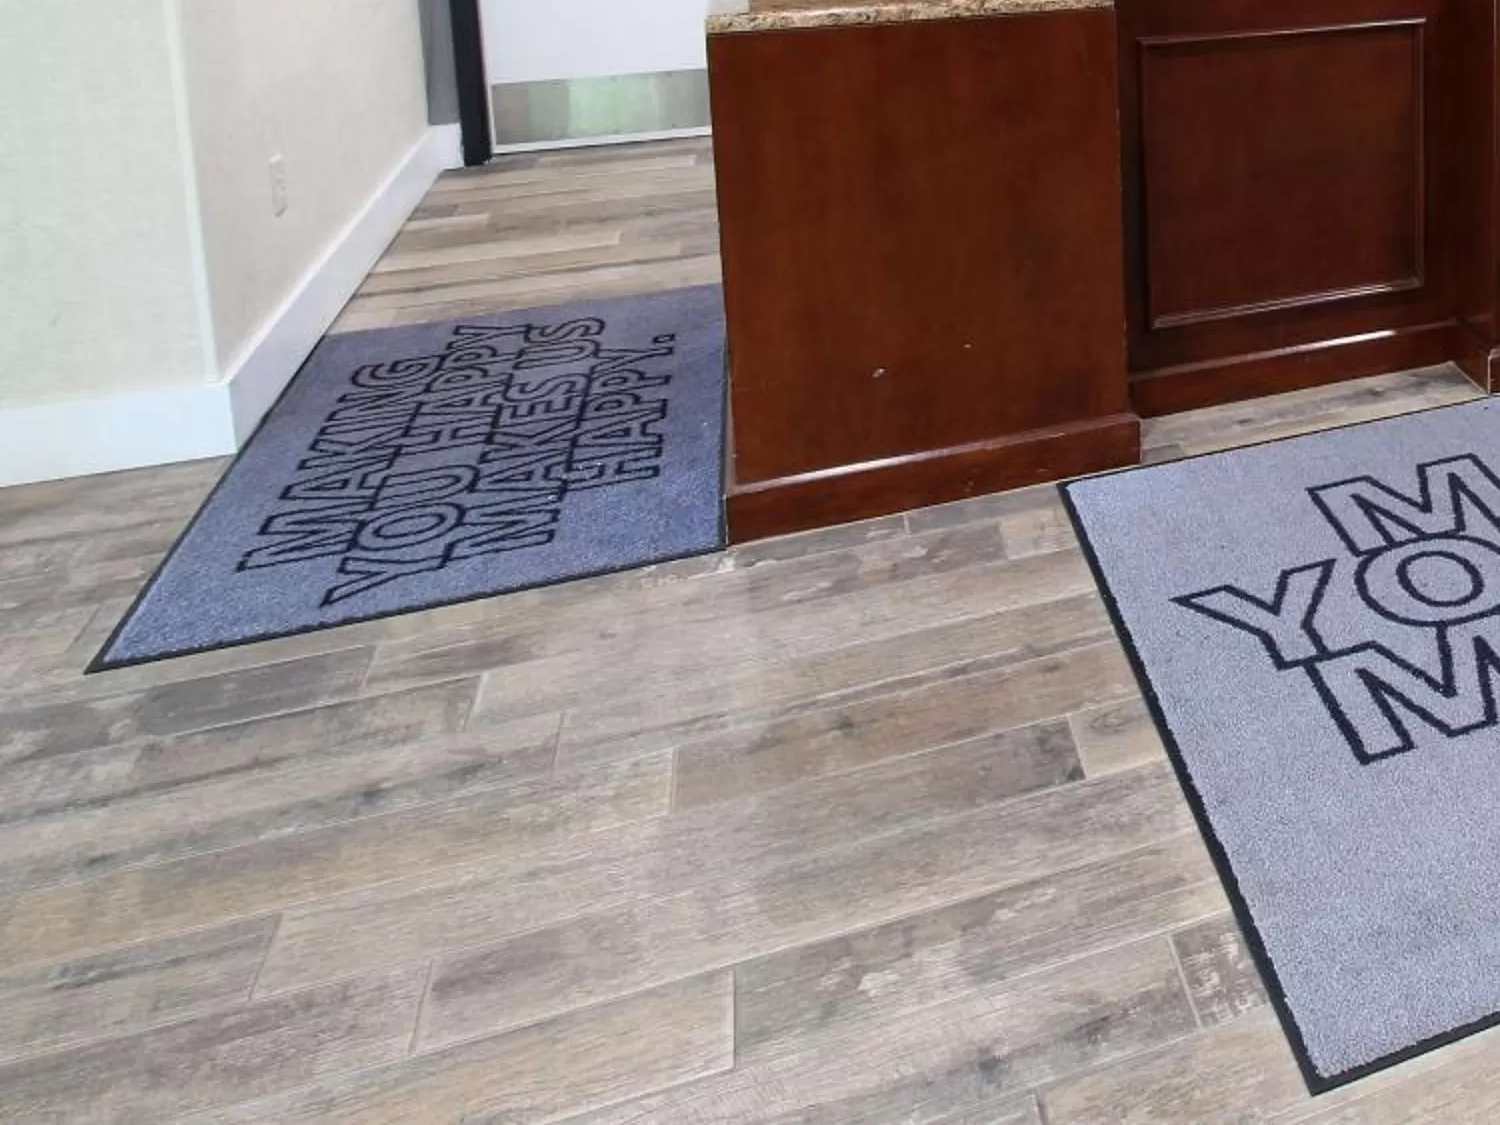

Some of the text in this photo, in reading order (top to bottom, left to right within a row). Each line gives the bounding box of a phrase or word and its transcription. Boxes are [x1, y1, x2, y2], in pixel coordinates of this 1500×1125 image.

[236, 352, 443, 573] MAKING
[320, 322, 531, 608] YOU HAPPY
[438, 316, 605, 568] MAKES US
[561, 333, 676, 493] HAPPY.
